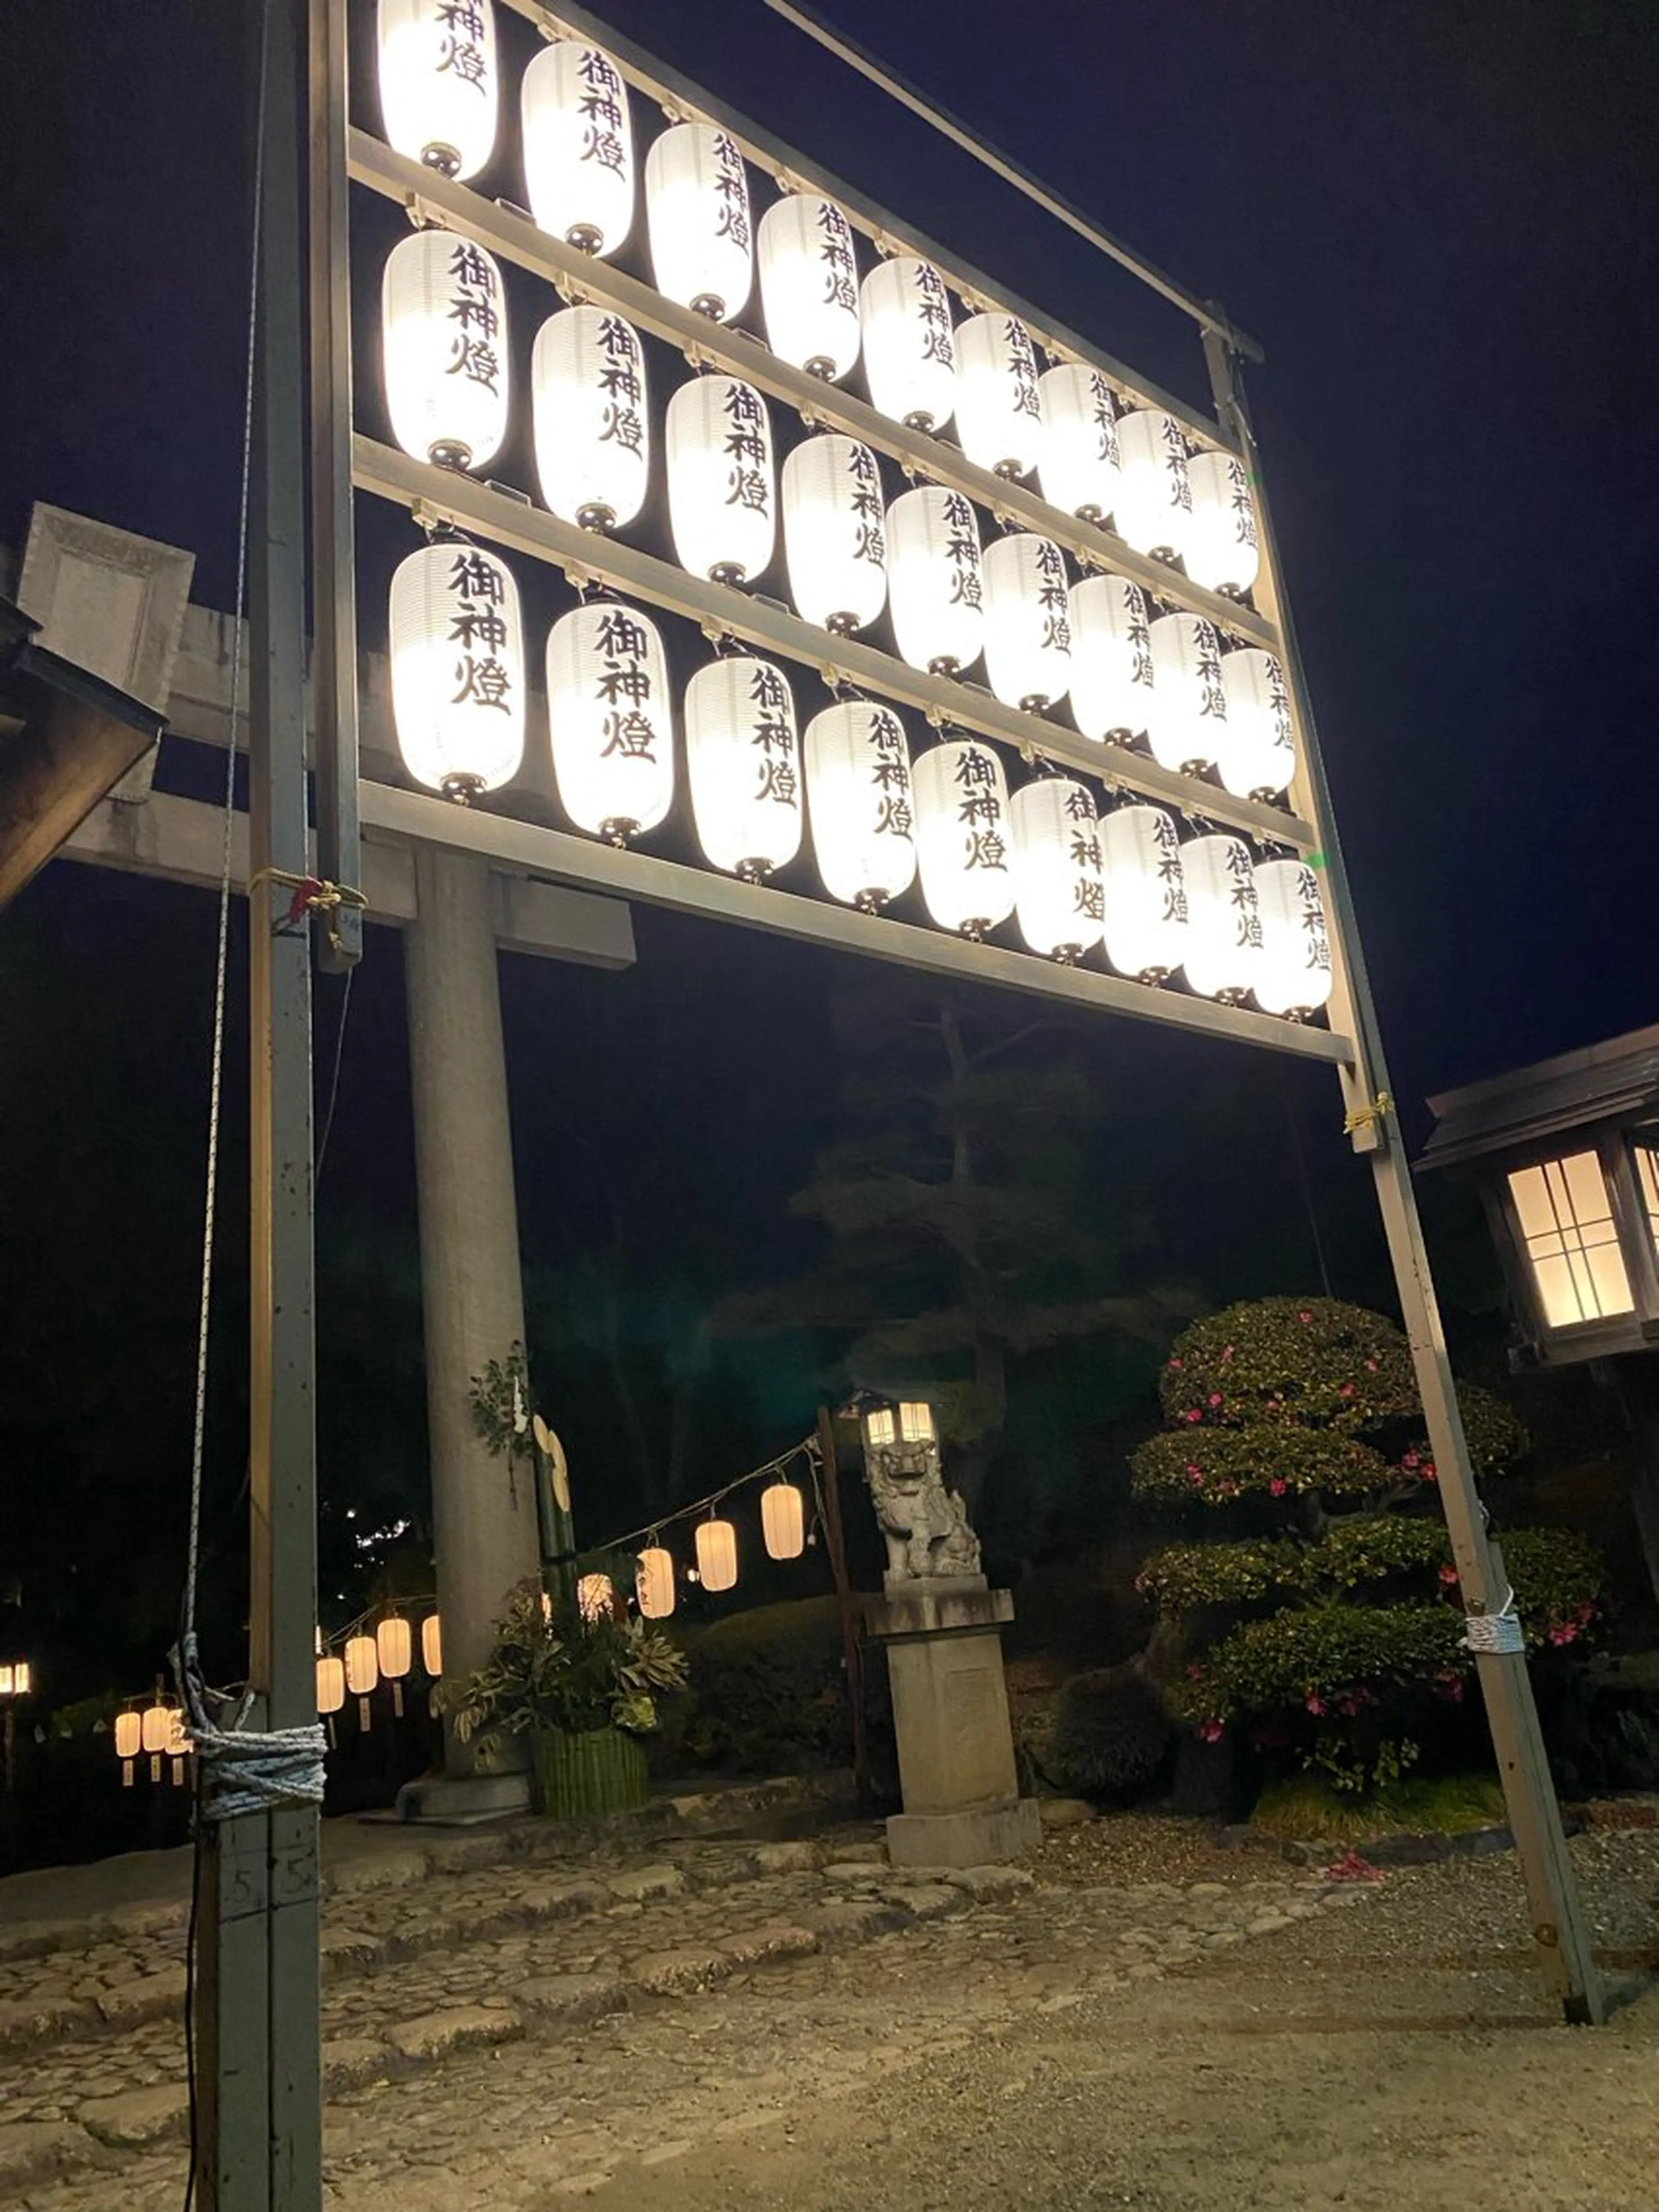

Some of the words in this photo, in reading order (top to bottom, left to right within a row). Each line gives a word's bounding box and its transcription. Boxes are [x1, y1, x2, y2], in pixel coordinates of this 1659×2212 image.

[435, 0, 487, 96] 神燈
[578, 51, 626, 183] 御神燈
[713, 135, 750, 257] 御神燈
[446, 245, 499, 398] 御神燈
[818, 203, 858, 318] 御神燈
[915, 265, 954, 375] 御神燈
[597, 317, 643, 462] 御神燈
[1005, 320, 1042, 422] 御神燈
[724, 385, 769, 519] 御神燈
[848, 445, 886, 569] 御神燈
[942, 493, 984, 613] 御神燈
[1036, 540, 1071, 658] 御神燈
[448, 551, 512, 716] 御神燈
[594, 611, 657, 764] 御神燈
[749, 668, 798, 809] 御神燈
[868, 712, 913, 842] 御神燈
[955, 747, 1009, 872] 御神燈
[1226, 845, 1265, 949] 御神燈
